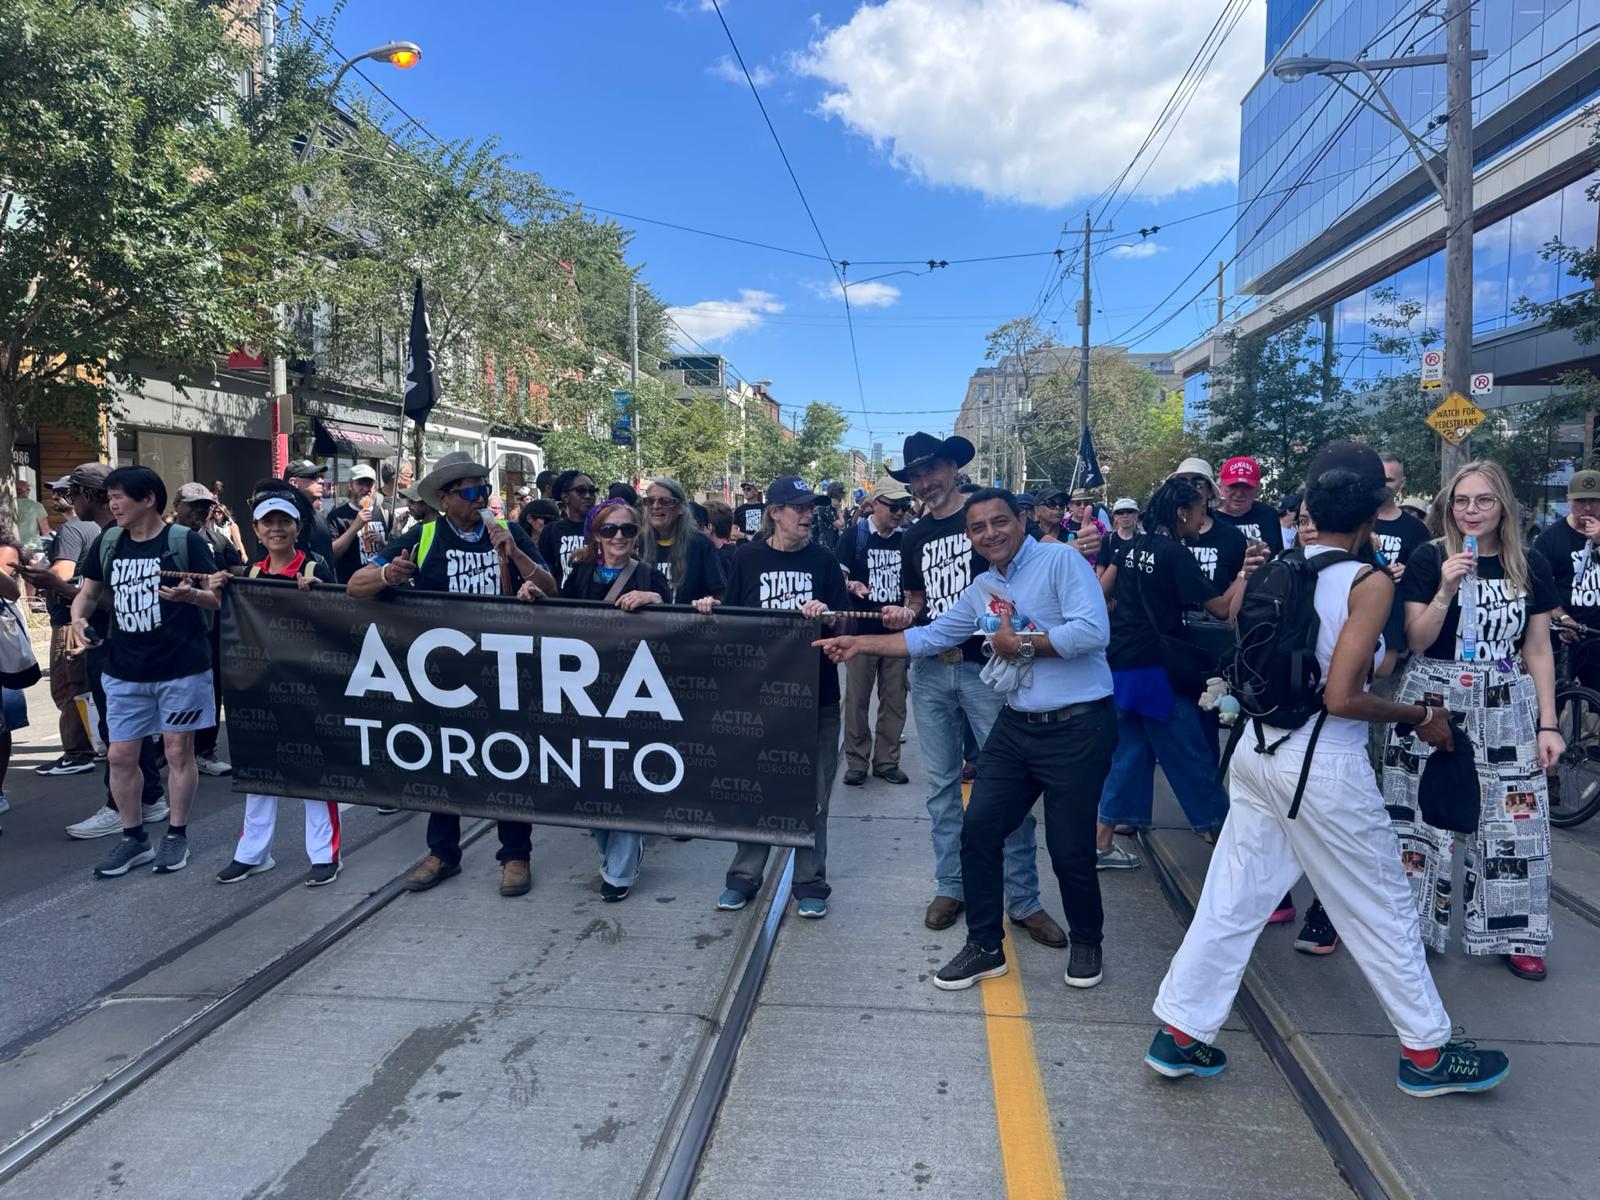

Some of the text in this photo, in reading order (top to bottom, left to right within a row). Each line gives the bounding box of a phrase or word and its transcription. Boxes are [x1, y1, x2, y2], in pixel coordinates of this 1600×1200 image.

[1437, 407, 1476, 418] WATCH FOR
[13, 450, 30, 464] 986
[1230, 462, 1253, 472] CANADA
[867, 549, 902, 568] STATUS
[922, 533, 972, 572] STATUS
[111, 558, 161, 586] STATUS
[869, 564, 902, 590] ARTIST
[923, 550, 972, 599] ARTIST
[760, 570, 812, 600] STATUS
[112, 576, 161, 613] ARTIST
[116, 603, 162, 632] NOW!
[268, 617, 316, 632] ACTRA
[664, 622, 720, 636] TORONTO
[760, 627, 816, 640] TORONTO
[226, 645, 271, 660] ACTRA
[616, 639, 671, 654] ACRA
[712, 643, 766, 658] ACTRA
[712, 657, 768, 670] TORONTO
[344, 622, 684, 721] ACTRA
[268, 682, 318, 695] ACTRA
[666, 675, 719, 690] ACTRA
[759, 680, 813, 697] ACTRA
[672, 689, 720, 701] ORONTO
[1472, 675, 1483, 708] Fashion
[270, 694, 320, 706] TORONTO
[759, 695, 814, 709] TORONTO
[230, 707, 278, 721] ACTRA
[528, 712, 580, 726] TORONTO
[712, 709, 764, 726] ACTRA
[230, 720, 279, 732] TORONTO
[618, 718, 673, 731] TORONTO
[712, 724, 765, 738] TORONTO
[276, 742, 324, 756] ACTRA
[344, 718, 685, 793] TORONTO
[757, 750, 811, 765] ACTRA
[238, 768, 284, 780] ACTRA
[758, 764, 812, 776] TORONTO
[320, 772, 366, 788] ACTRA
[710, 776, 762, 792] ACTRA
[402, 782, 449, 798] ACTRA
[709, 790, 764, 804] TORONTO
[486, 792, 536, 808] ACTRA
[573, 800, 624, 816] ACTRA
[664, 808, 716, 823] ACTRA
[756, 816, 810, 831] ACTRA
